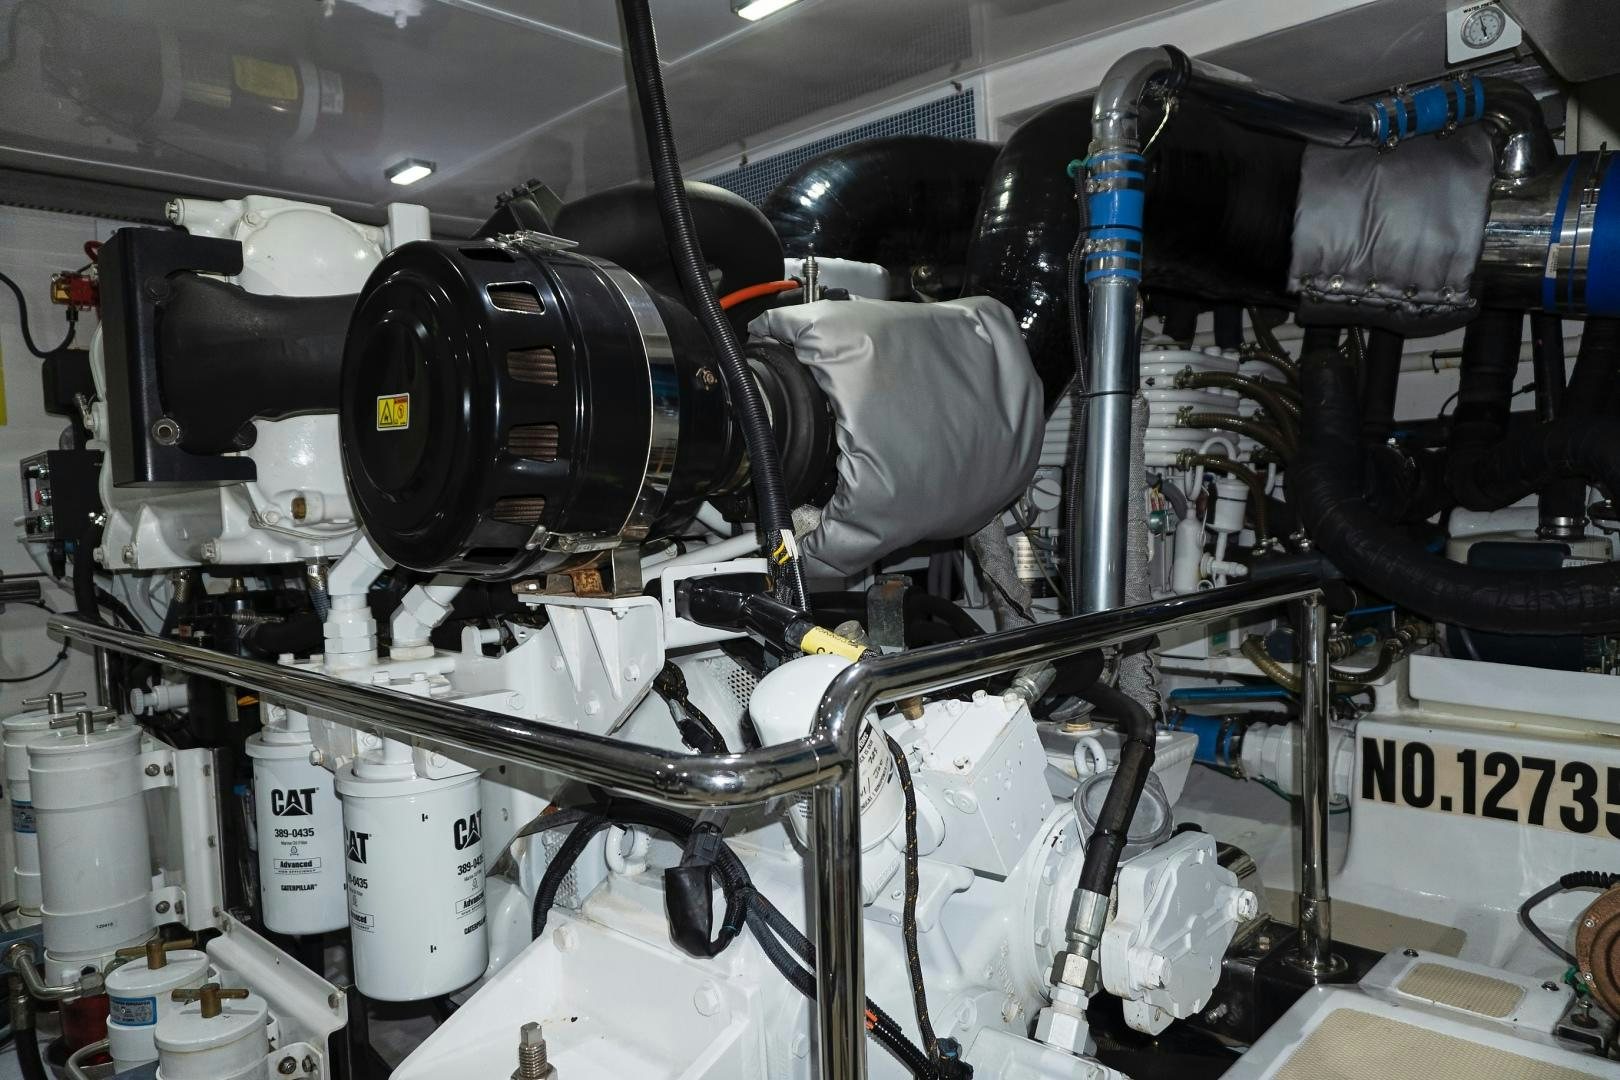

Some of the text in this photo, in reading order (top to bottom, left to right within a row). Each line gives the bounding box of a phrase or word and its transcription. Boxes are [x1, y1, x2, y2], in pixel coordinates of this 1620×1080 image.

[271, 787, 314, 816] CAT
[274, 828, 315, 838] 389-0435
[343, 825, 369, 865] AT
[279, 860, 313, 869] Advanced
